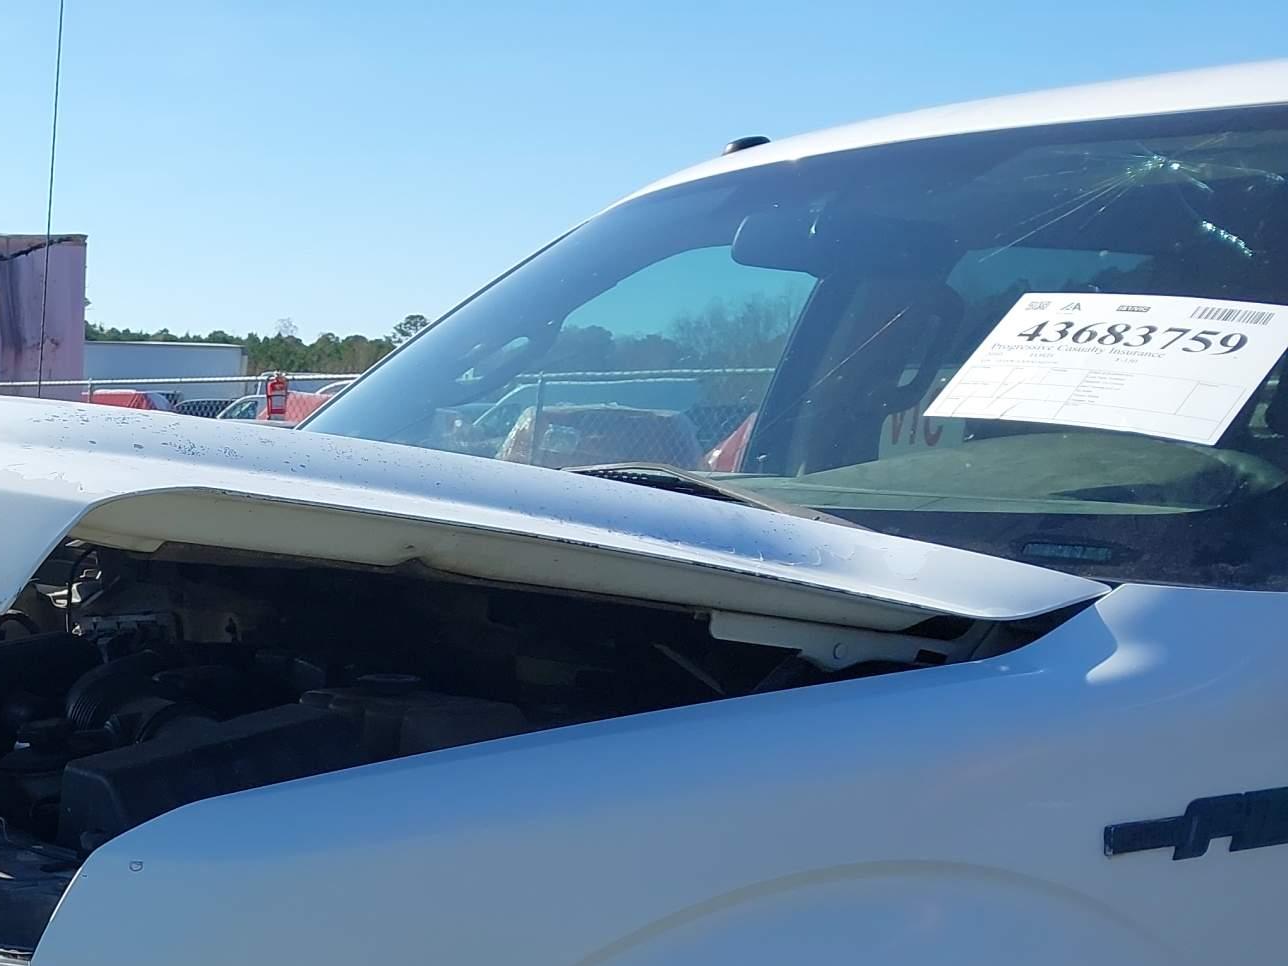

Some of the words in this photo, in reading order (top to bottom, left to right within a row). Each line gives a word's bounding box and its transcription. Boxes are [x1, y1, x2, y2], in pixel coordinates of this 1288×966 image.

[991, 343, 1055, 352] Progressive
[1057, 344, 1105, 354] Casualty
[1108, 345, 1166, 358] Insurance
[1016, 319, 1249, 356] 43683759
